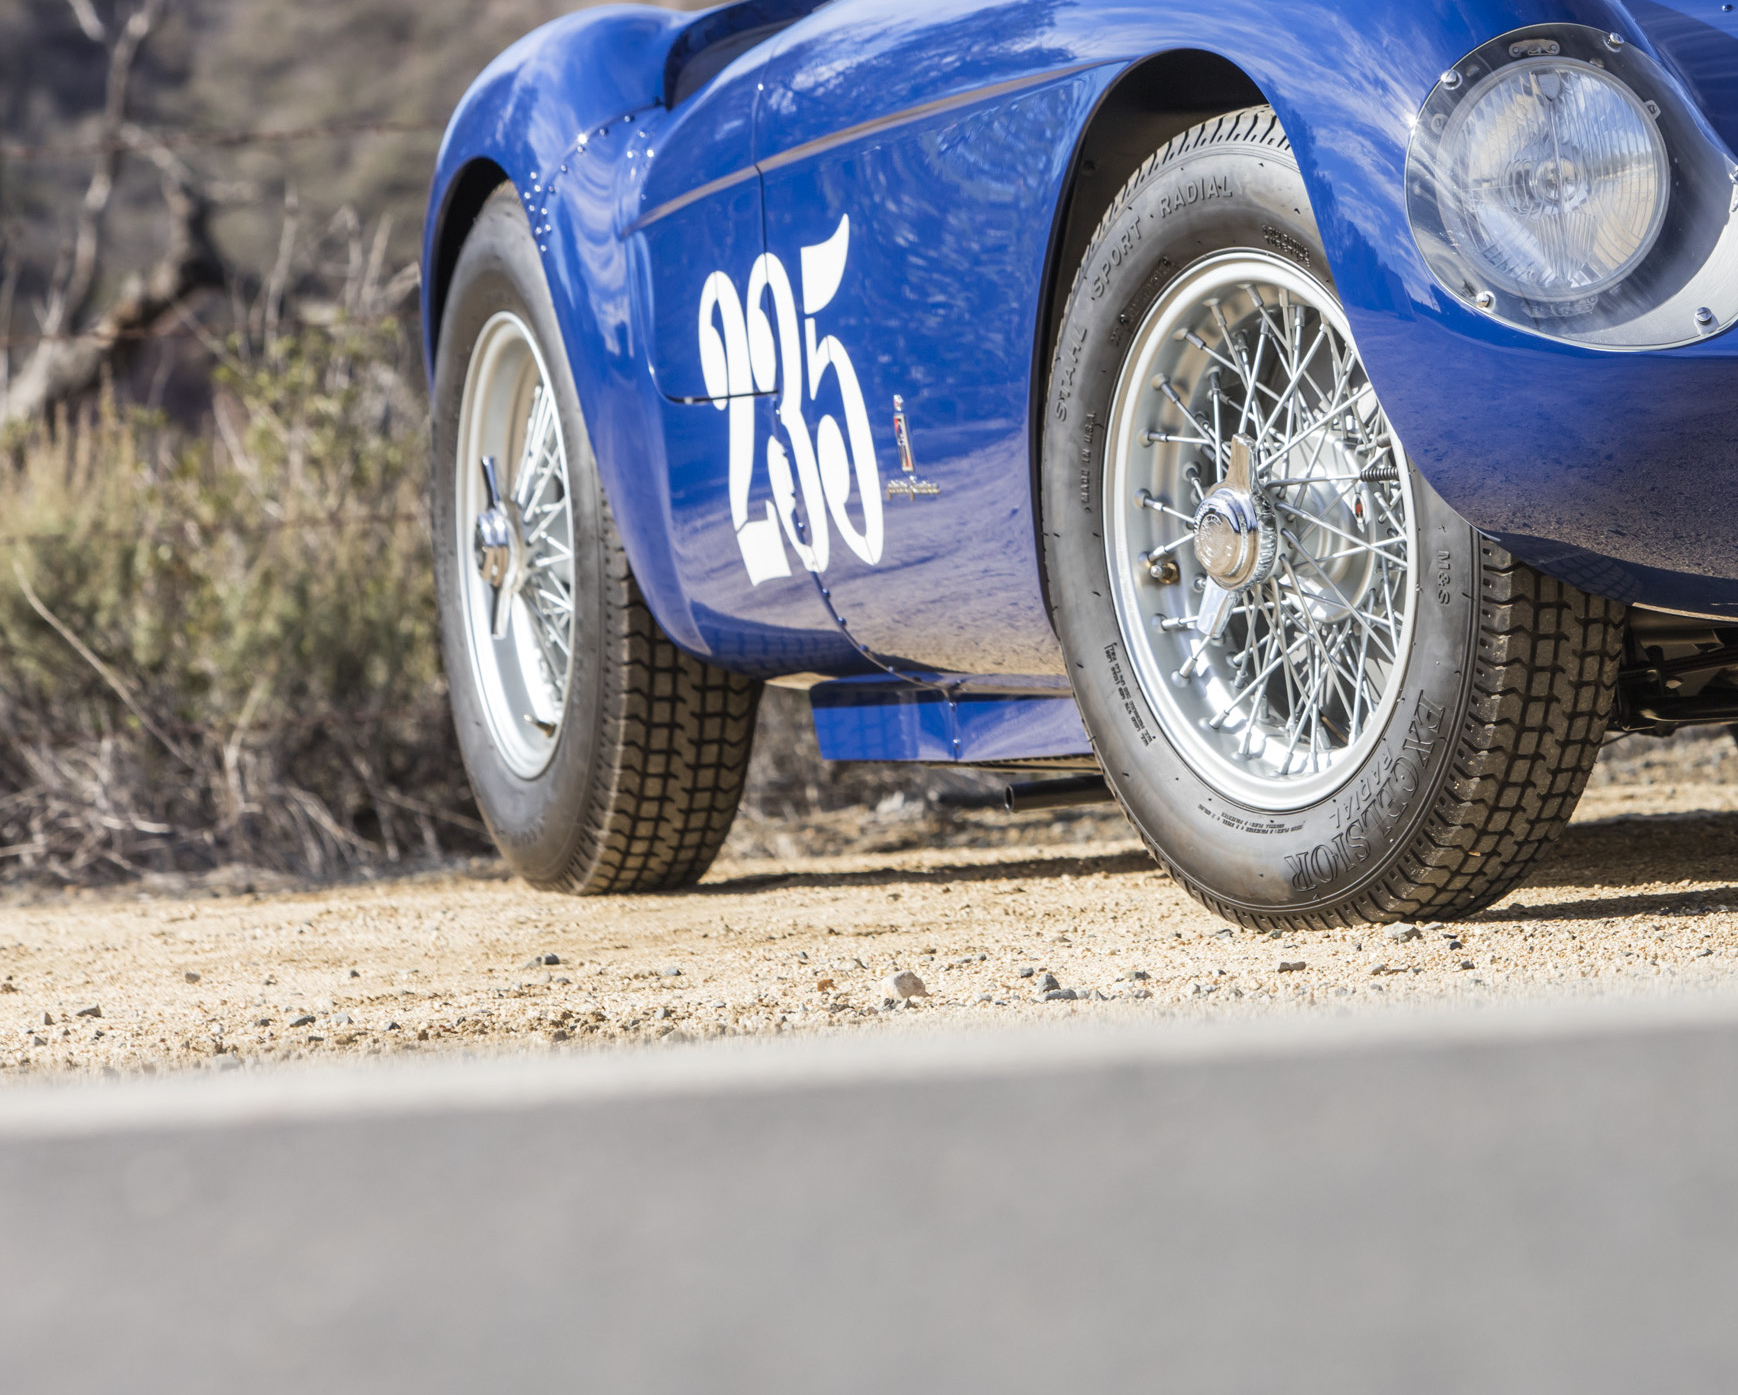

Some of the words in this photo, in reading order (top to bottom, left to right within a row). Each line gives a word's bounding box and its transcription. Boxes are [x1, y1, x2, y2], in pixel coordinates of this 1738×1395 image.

[699, 214, 884, 586] 235
[1056, 325, 1088, 422] STAHL
[1092, 216, 1142, 298] SPORT
[1159, 175, 1233, 218] RADIAL
[1438, 550, 1450, 604] M&S
[1284, 689, 1445, 892] EXCELSIOR
